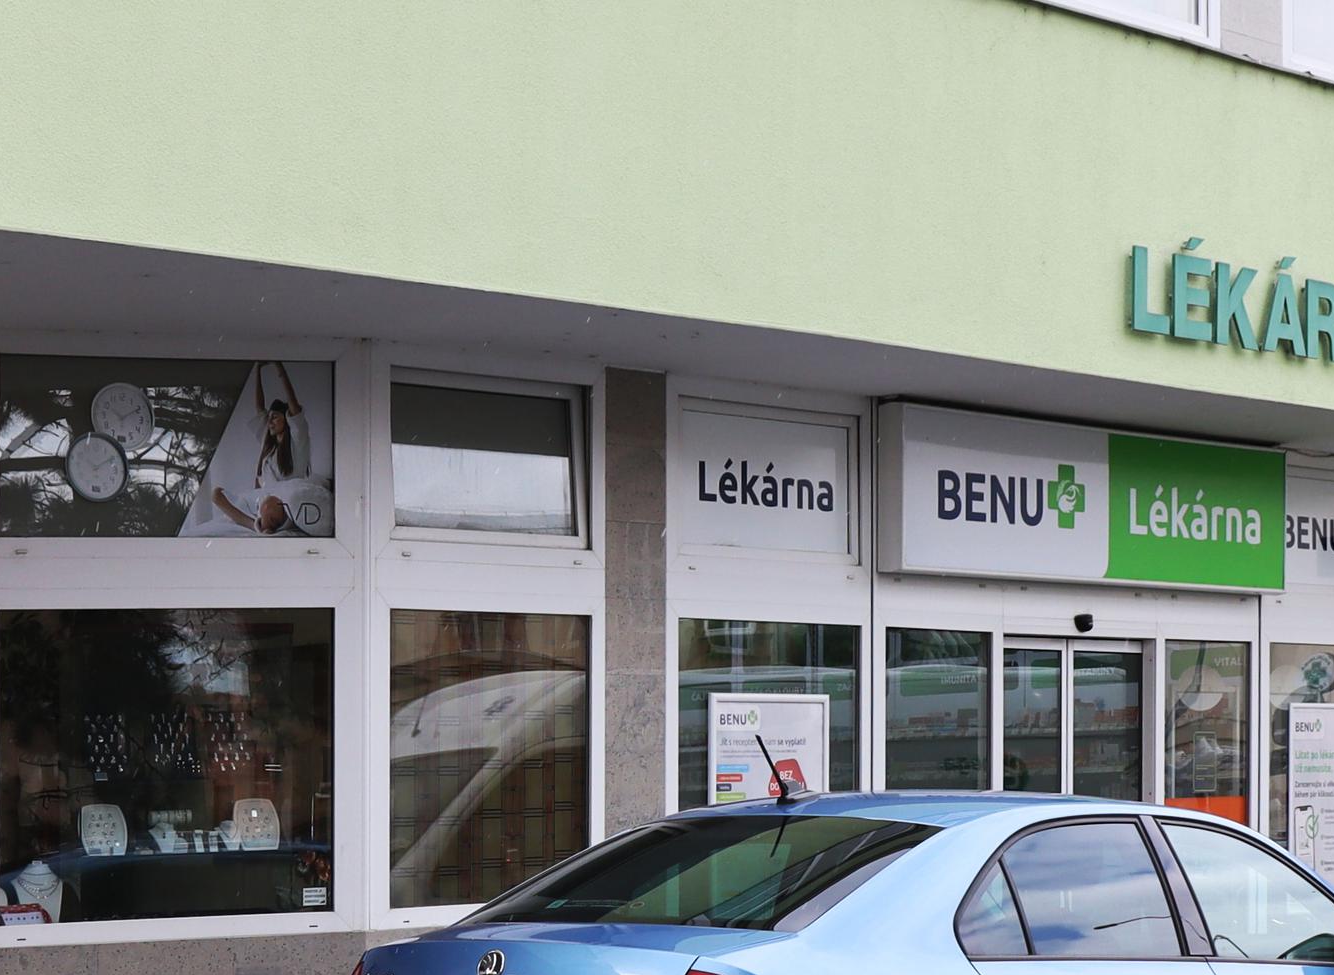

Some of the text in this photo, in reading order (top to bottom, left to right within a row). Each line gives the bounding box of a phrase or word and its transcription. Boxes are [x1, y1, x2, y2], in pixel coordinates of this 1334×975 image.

[697, 458, 834, 513] Lékárna
[936, 470, 1044, 527] BENU
[1129, 486, 1262, 545] Lékárna
[720, 713, 747, 725] BENU
[1295, 722, 1315, 732] BENU
[779, 770, 793, 780] BEZ
